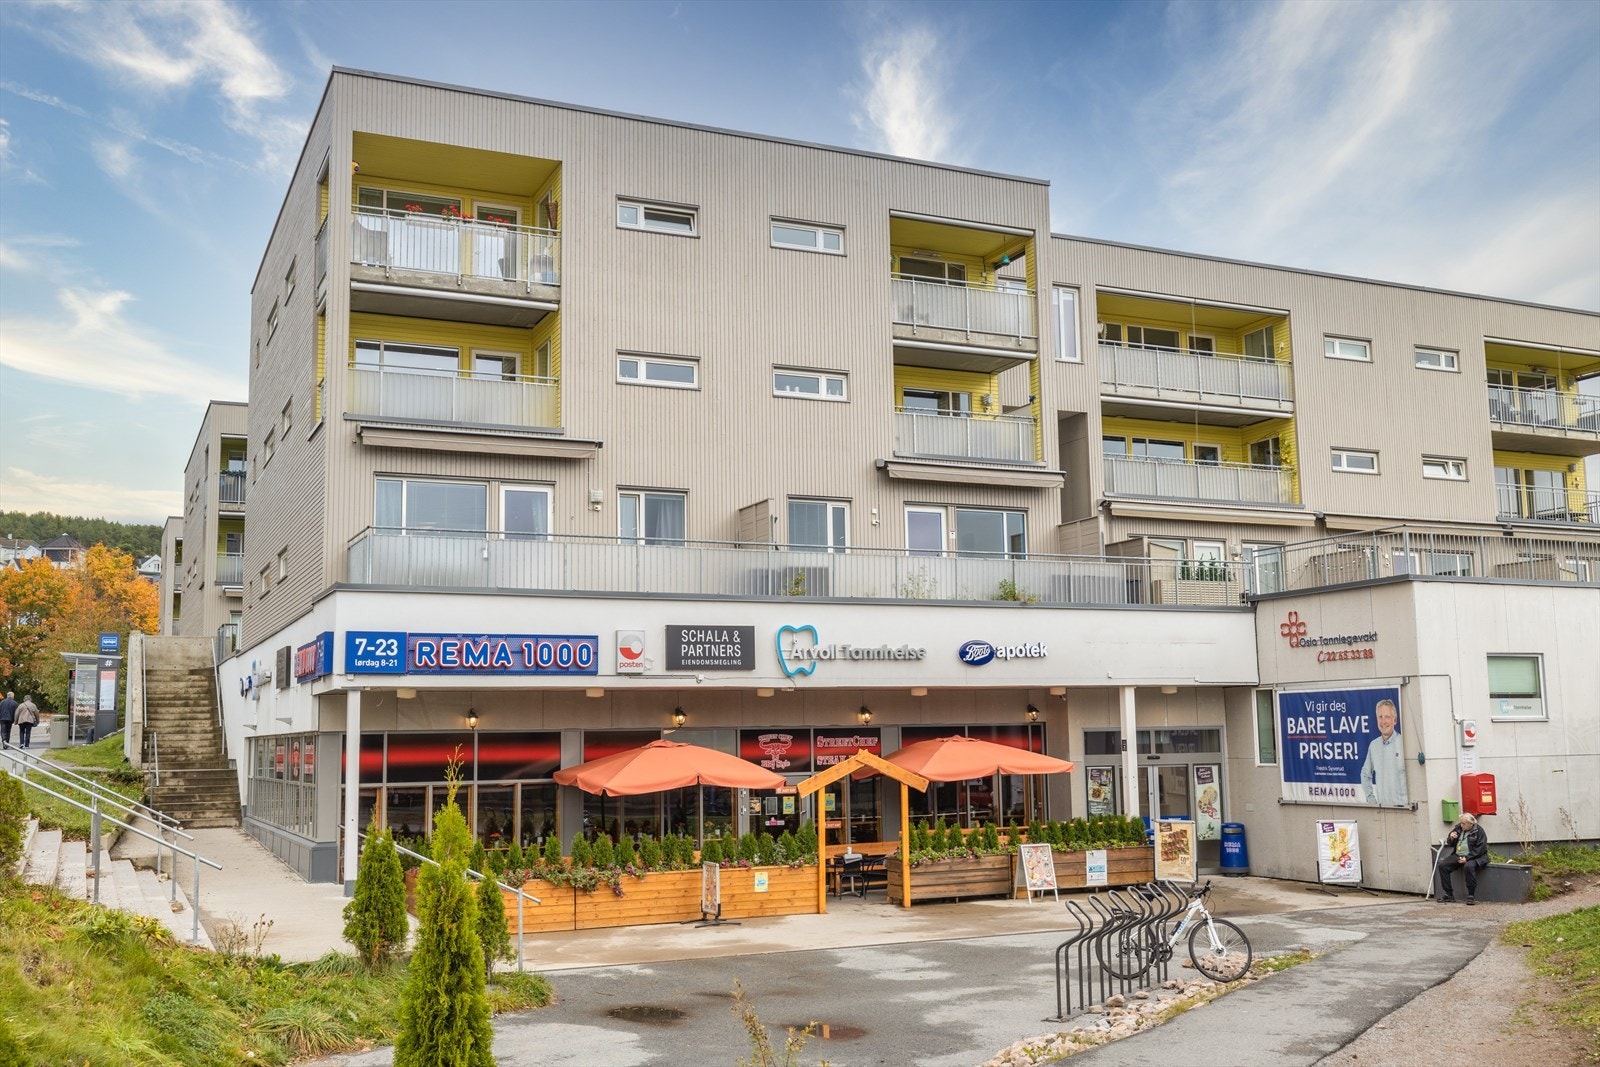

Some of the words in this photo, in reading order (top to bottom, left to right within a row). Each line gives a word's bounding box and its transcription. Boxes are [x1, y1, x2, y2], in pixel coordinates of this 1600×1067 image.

[681, 629, 729, 643] SCHALA
[732, 630, 741, 642] &
[1299, 637, 1317, 648] Oslo
[1319, 631, 1378, 647] Tannlegevakt
[355, 638, 398, 656] 7-23
[414, 640, 514, 668] REMA
[522, 641, 594, 668] 1000
[681, 644, 742, 657] PARTNERS
[790, 638, 836, 660] Årvoll
[841, 644, 927, 661] Tannhelse
[963, 644, 991, 662] Boots
[995, 641, 1048, 661] apotek
[1326, 651, 1336, 661] 22
[1338, 650, 1348, 660] 65
[1350, 649, 1360, 660] 33
[1363, 648, 1374, 659] 88
[355, 658, 380, 668] lørdag
[380, 659, 398, 667] 8-21
[1305, 701, 1315, 711] Vi
[1316, 701, 1328, 714] gir
[1330, 700, 1346, 712] deg
[1287, 717, 1326, 734] BARE
[1330, 716, 1370, 734] LAVE
[1300, 742, 1358, 760] PRISER!
